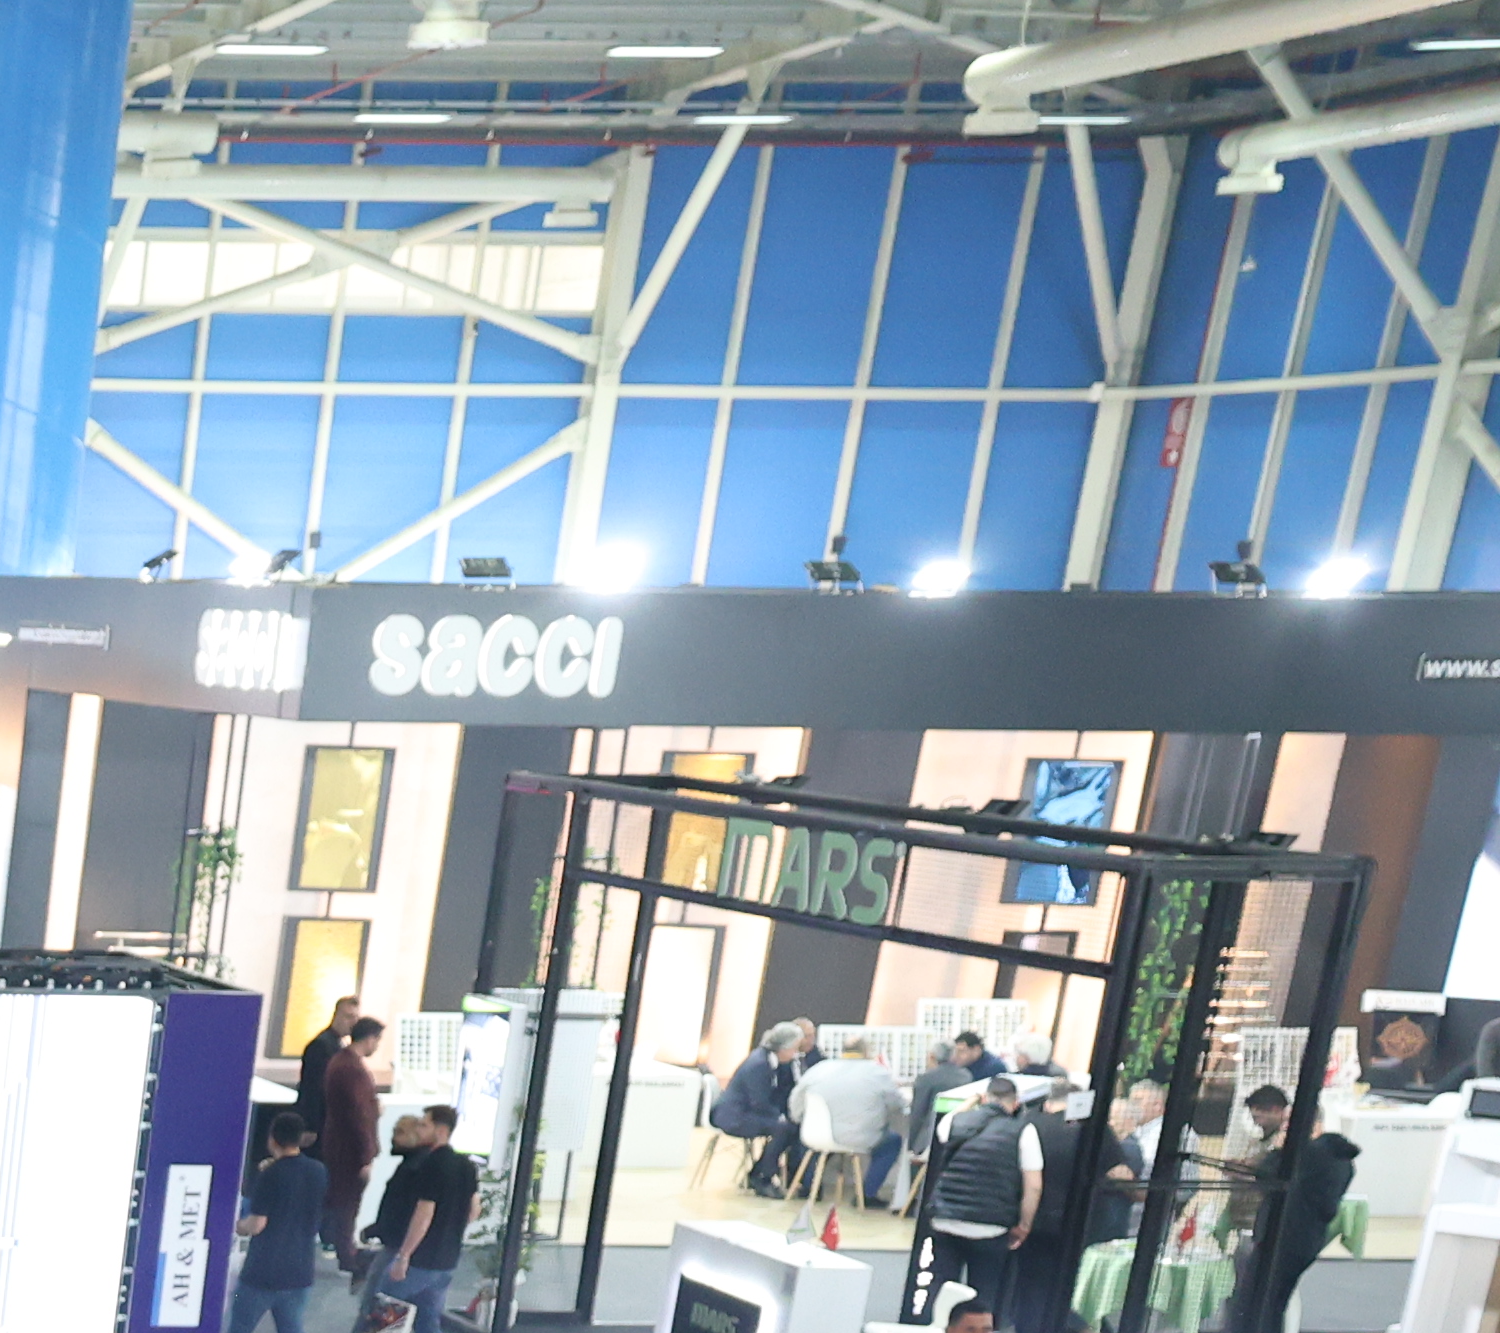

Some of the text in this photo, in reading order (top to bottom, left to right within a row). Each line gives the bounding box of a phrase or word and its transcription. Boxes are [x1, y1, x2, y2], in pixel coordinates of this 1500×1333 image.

[172, 1185, 202, 1308] AH & MET
